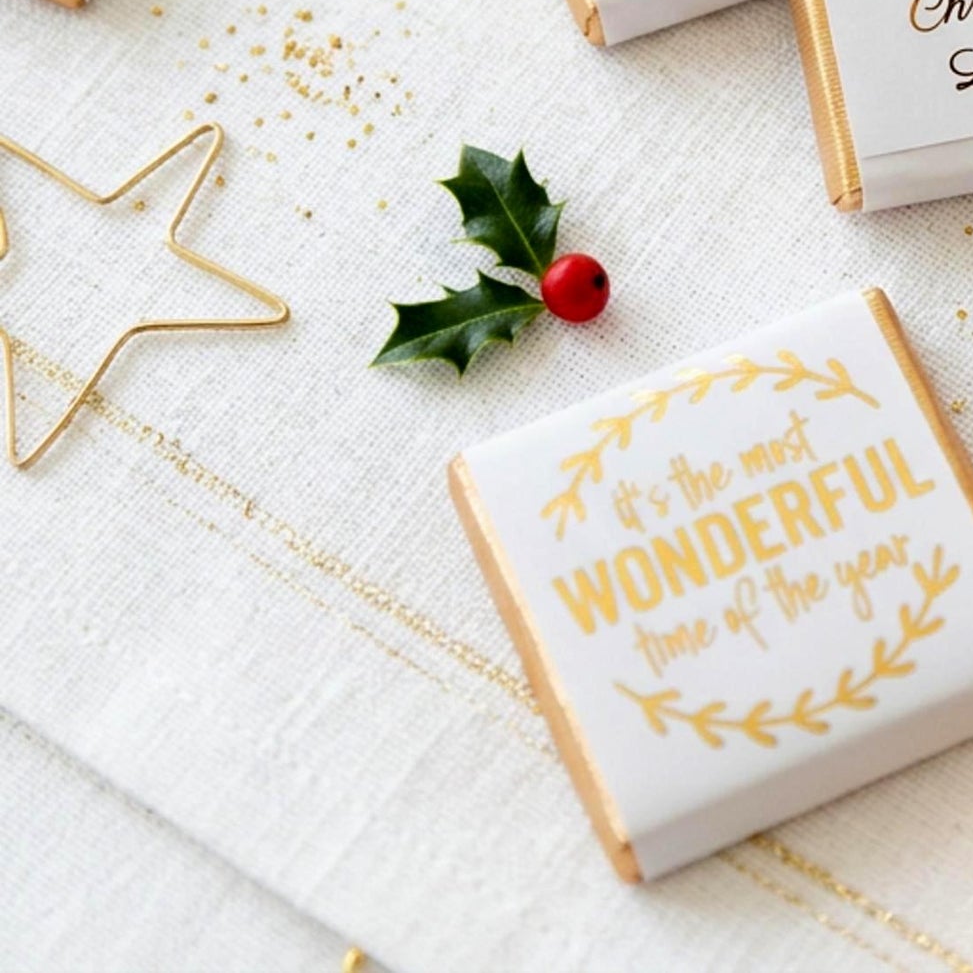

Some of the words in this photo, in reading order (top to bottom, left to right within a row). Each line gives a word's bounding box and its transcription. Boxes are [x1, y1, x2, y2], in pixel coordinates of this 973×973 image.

[552, 437, 936, 636] WONDERFUL
[612, 479, 670, 533] it's
[668, 454, 732, 510] the
[738, 409, 820, 477] most
[634, 620, 717, 678] time
[723, 577, 770, 651] of
[764, 566, 830, 623] the
[835, 534, 909, 623] year
